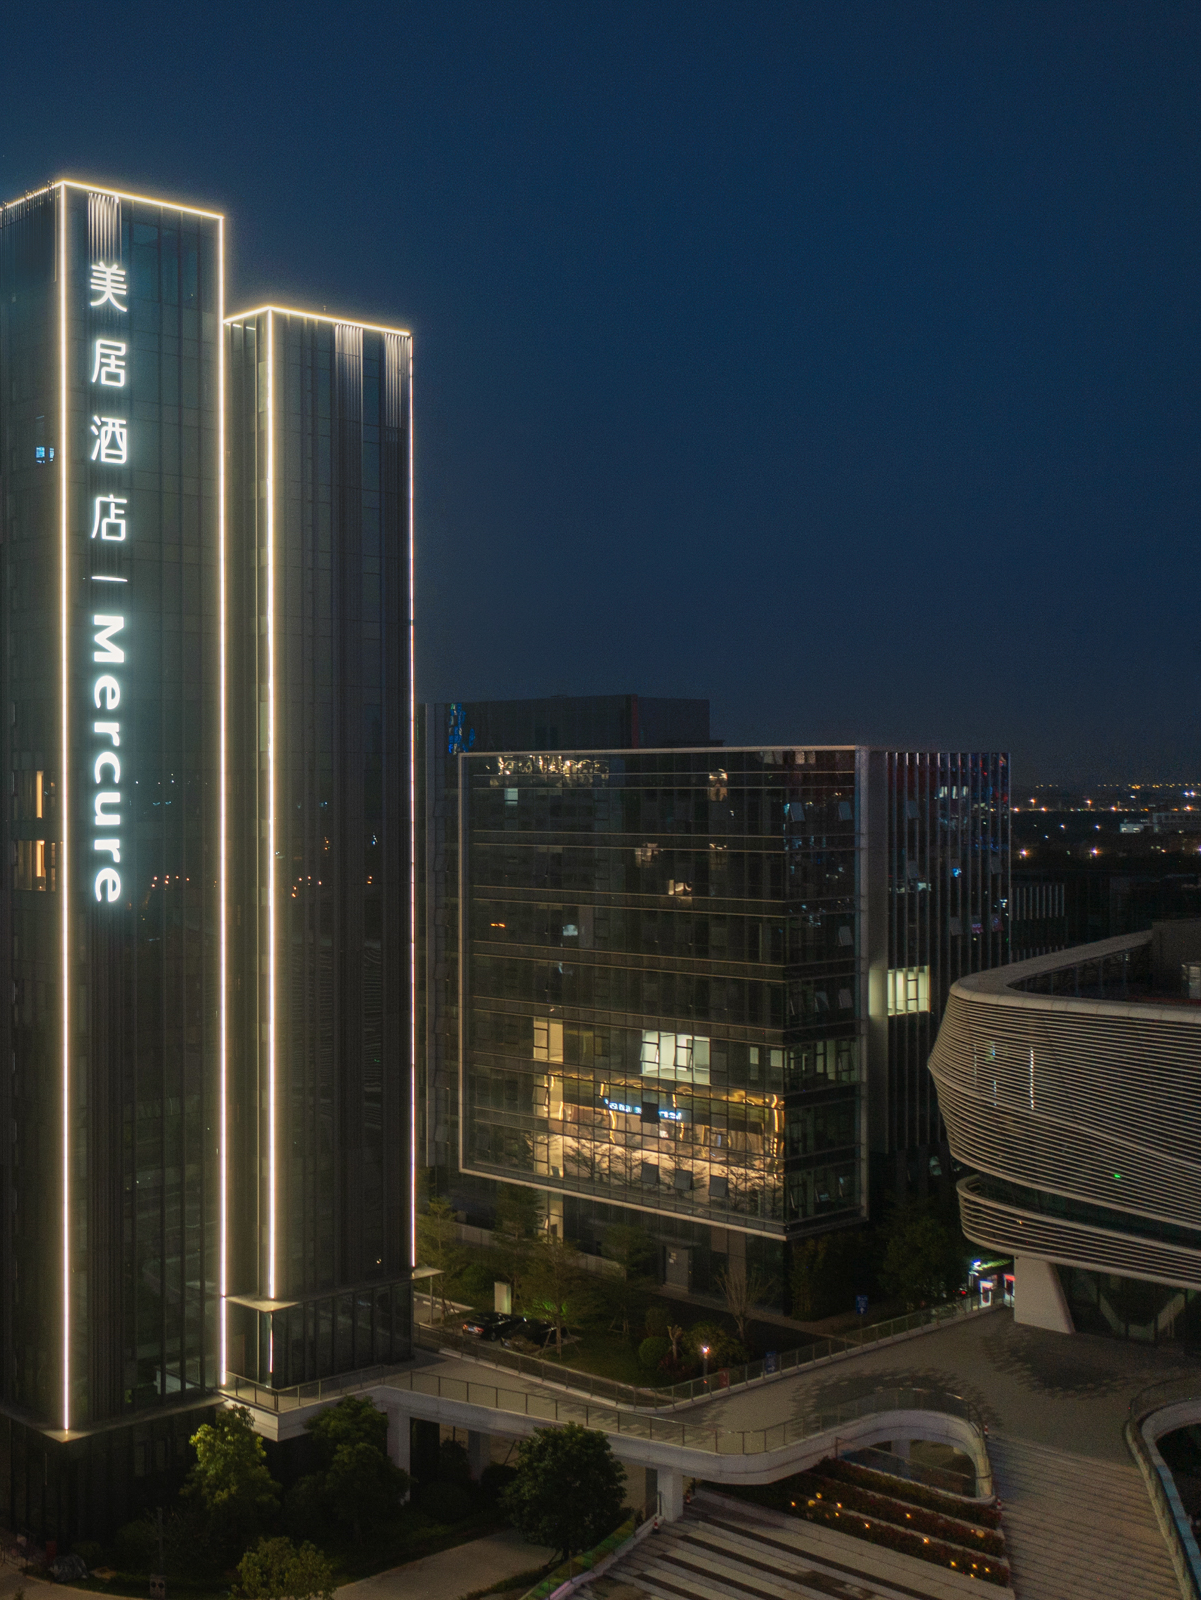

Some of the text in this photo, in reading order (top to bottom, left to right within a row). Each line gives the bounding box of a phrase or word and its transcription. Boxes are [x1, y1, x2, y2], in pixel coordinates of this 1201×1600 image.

[90, 260, 128, 542] 美居酒店
[92, 613, 126, 904] Mercure
